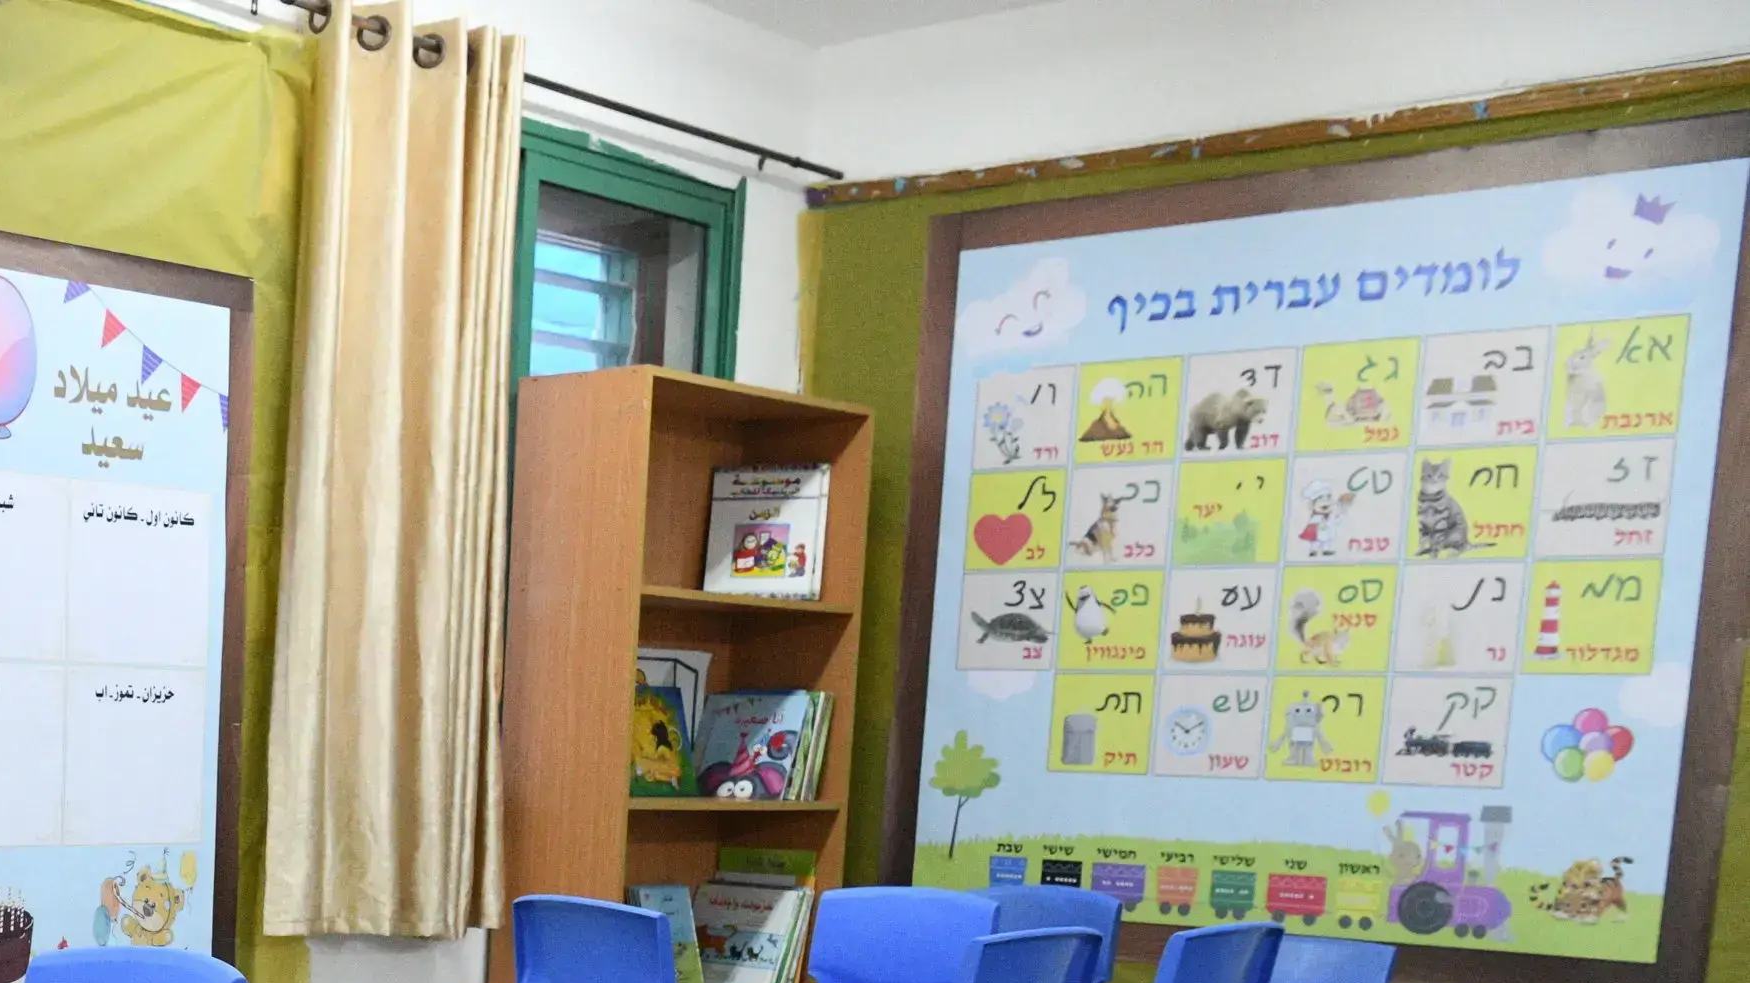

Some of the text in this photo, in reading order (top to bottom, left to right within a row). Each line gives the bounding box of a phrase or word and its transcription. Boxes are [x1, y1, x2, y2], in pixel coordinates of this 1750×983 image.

[1107, 246, 1522, 334] לומדים עברית בכיף
[53, 364, 172, 422] عيد ميلاد
[1496, 419, 1536, 437] בית
[1601, 409, 1674, 432] ארנבת
[1250, 433, 1280, 450] דוב
[1362, 424, 1400, 443] גמל
[82, 425, 145, 468] سعيد
[1033, 447, 1059, 460] ורד
[106, 504, 138, 523] كانون
[146, 509, 162, 527] اول
[163, 511, 195, 528] كانون
[1473, 521, 1526, 539] חתול
[1613, 527, 1654, 546] זחל
[1123, 544, 1156, 559] כלב
[1348, 536, 1390, 552] טבח
[1025, 546, 1046, 560] לב
[1331, 612, 1377, 629] סנאי
[1225, 632, 1266, 649] עוגה
[1022, 645, 1043, 660] צב
[1485, 646, 1507, 663] נר
[1565, 644, 1640, 664] מגדלור
[1103, 751, 1138, 768] תיק
[1207, 752, 1249, 772] שעון
[1320, 757, 1372, 774] רובוט
[1450, 762, 1494, 779] קטר
[996, 842, 1023, 854] שבת
[1042, 844, 1075, 857] שישי
[1097, 847, 1138, 860] חמישי
[1160, 851, 1195, 864] רביעי
[1213, 853, 1256, 868] שלישי
[1284, 858, 1308, 871] שני
[1338, 862, 1380, 876] ראשון
